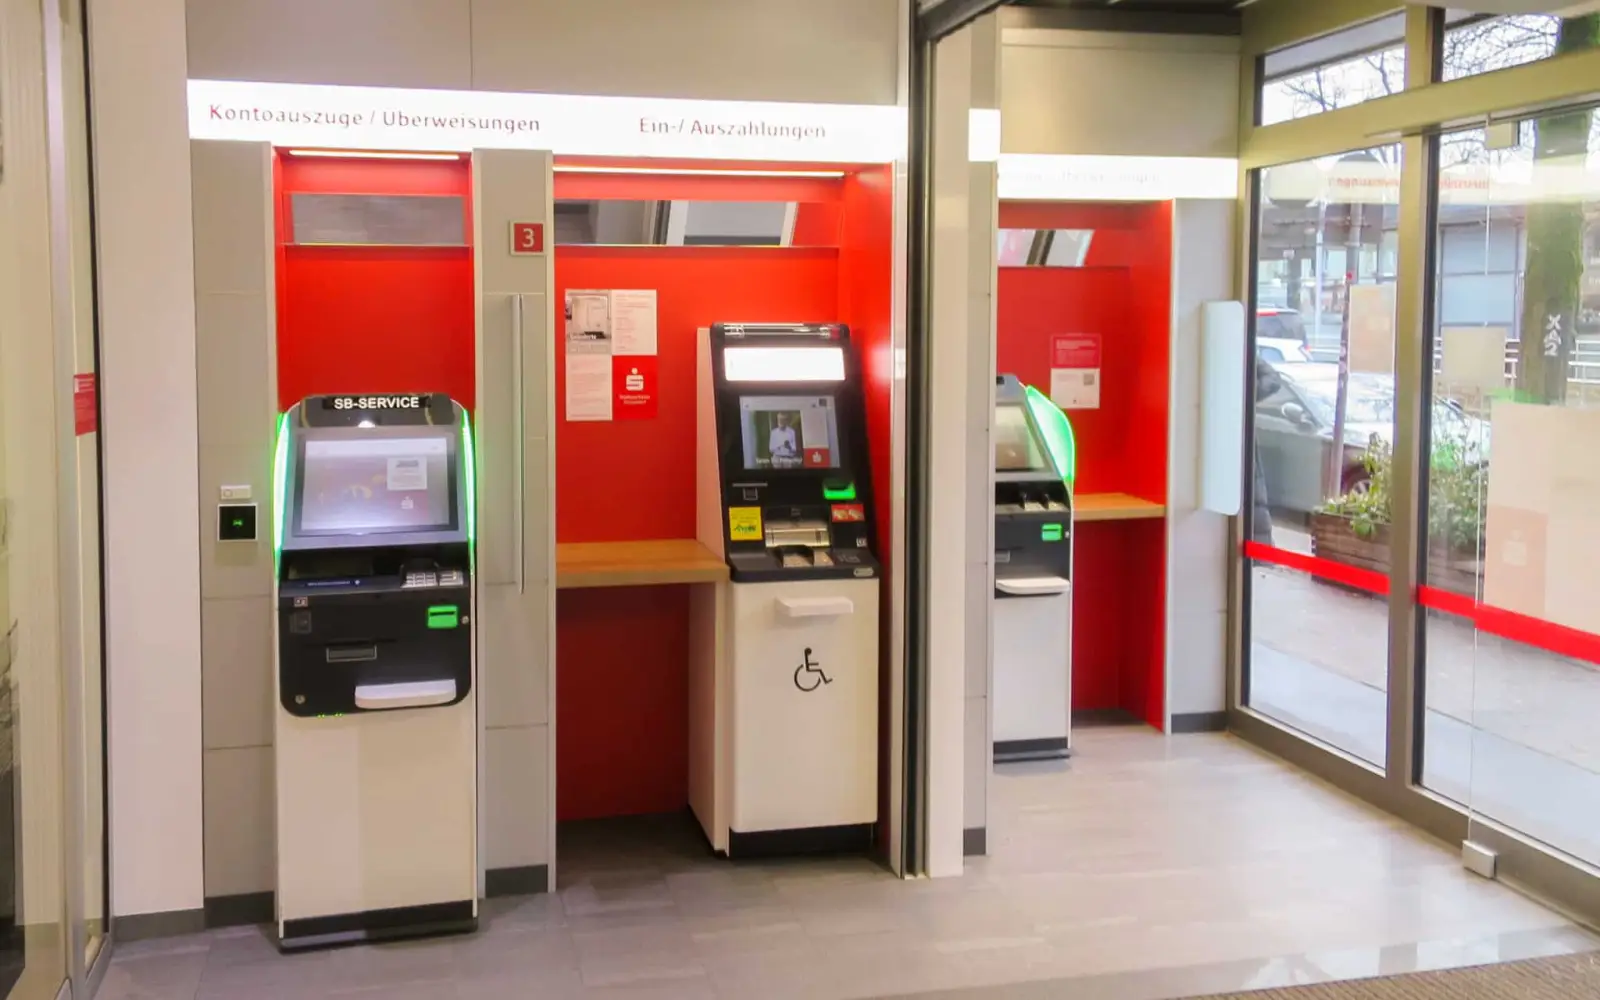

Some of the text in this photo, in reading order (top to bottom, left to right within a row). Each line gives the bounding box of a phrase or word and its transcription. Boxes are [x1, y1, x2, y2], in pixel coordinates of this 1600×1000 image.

[369, 109, 376, 125] /
[690, 119, 826, 141] Auszahlungen
[522, 228, 535, 248] 3
[333, 396, 420, 409] SB-SERVICE
